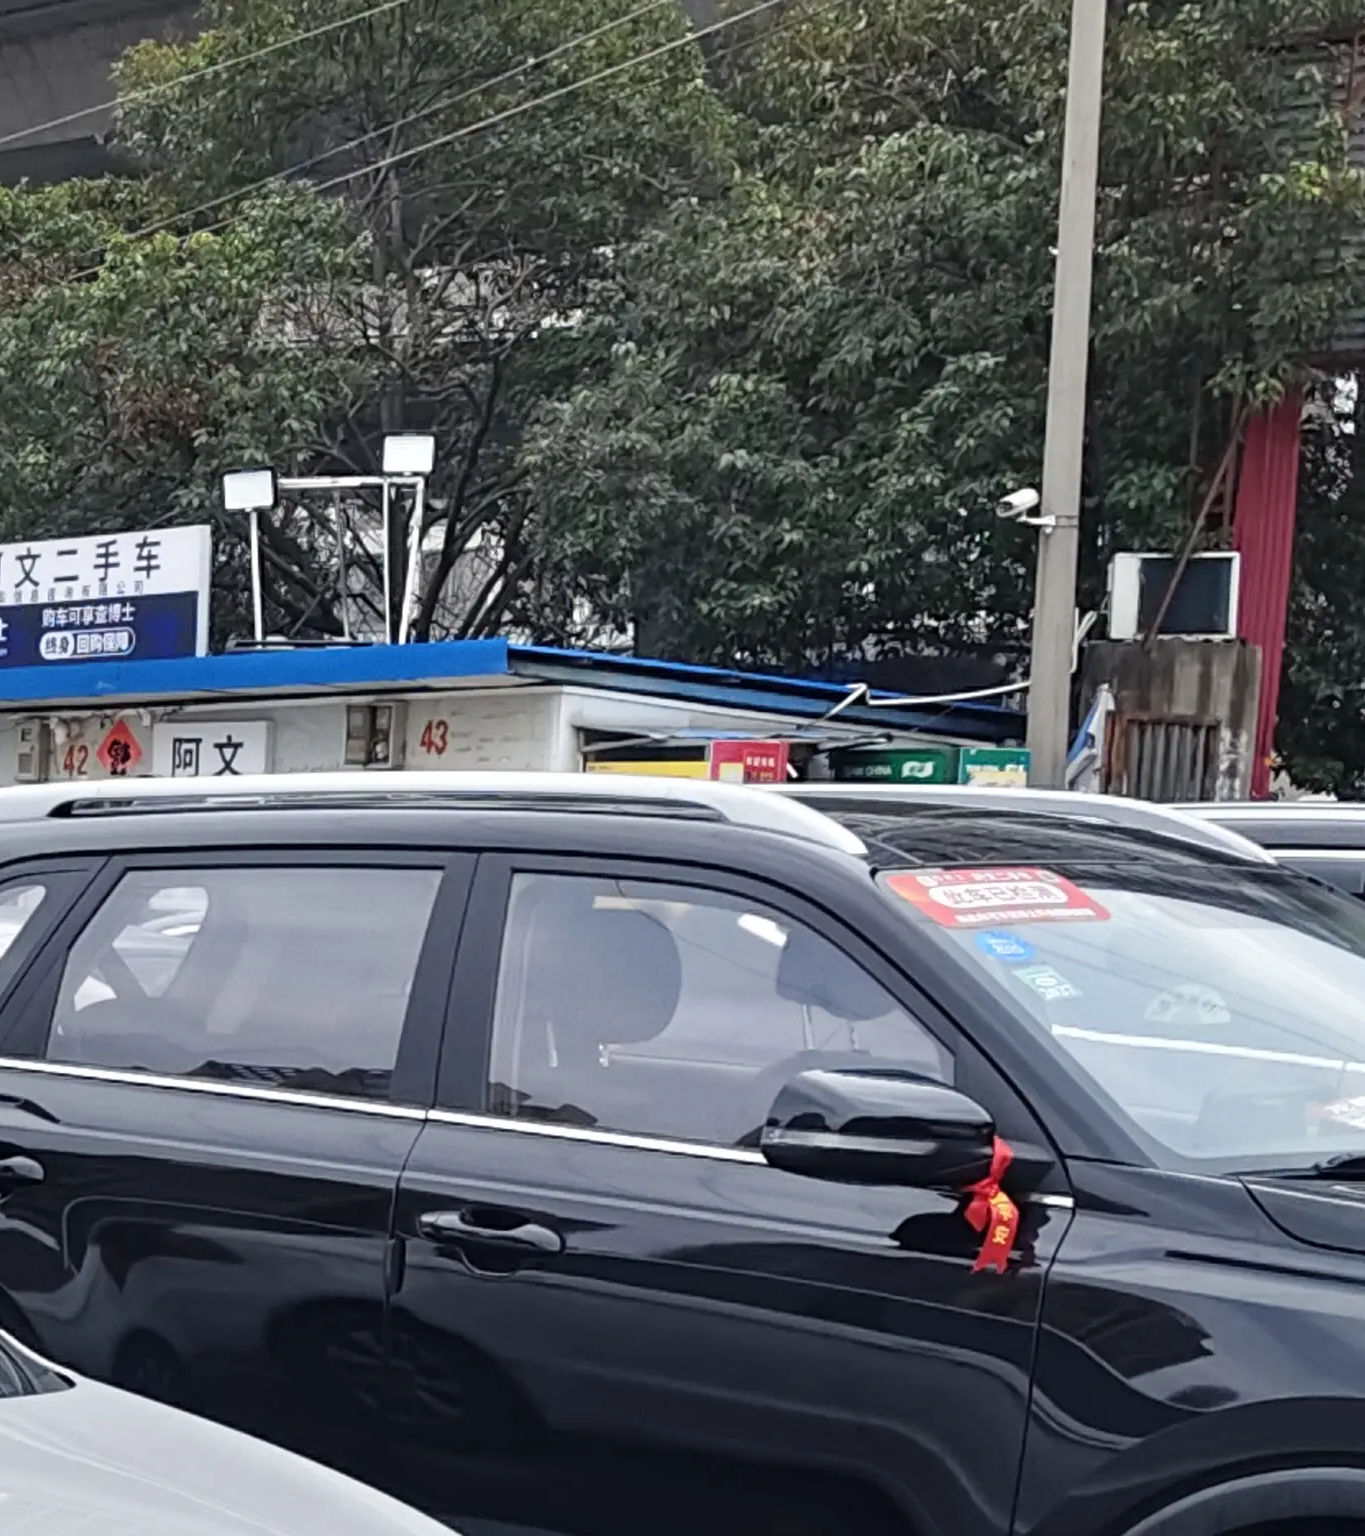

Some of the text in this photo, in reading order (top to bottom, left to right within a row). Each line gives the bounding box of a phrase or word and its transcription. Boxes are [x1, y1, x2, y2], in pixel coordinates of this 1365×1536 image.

[42, 602, 137, 629] 购车可享查博士
[420, 719, 449, 756] 43
[63, 744, 89, 776] 42
[172, 734, 244, 777] 阿文
